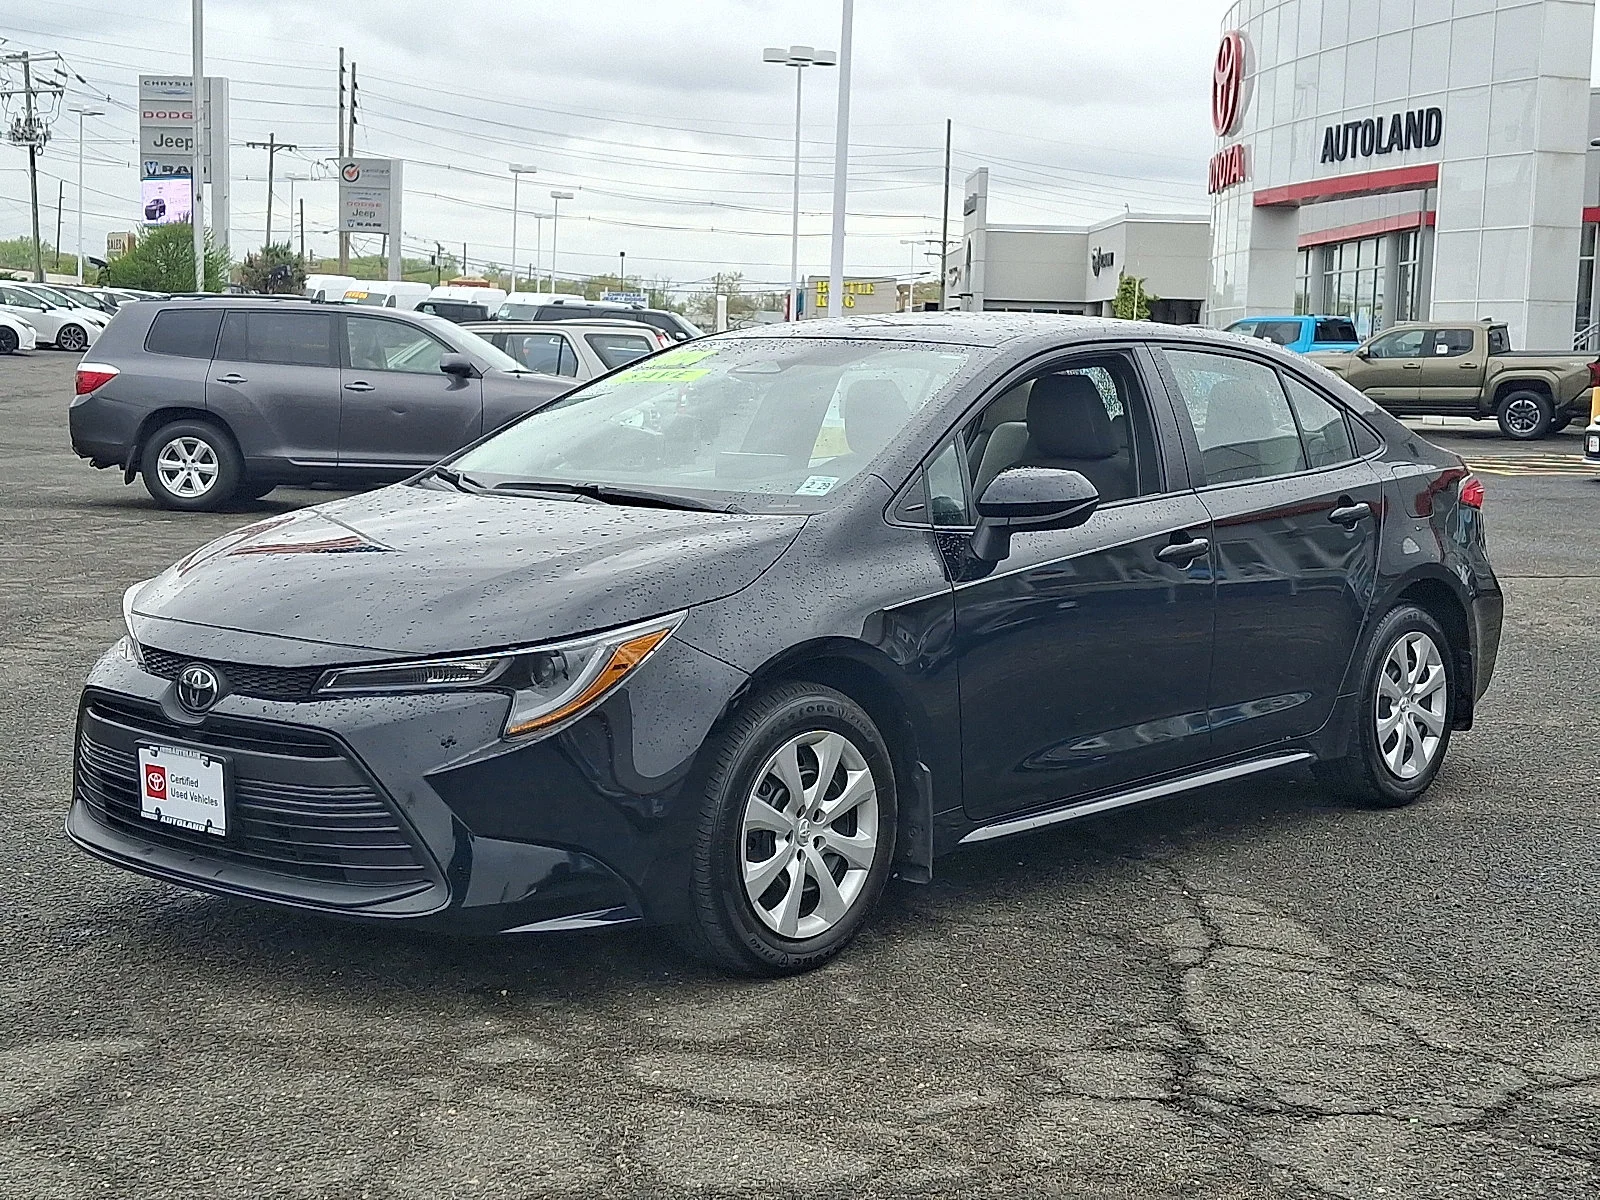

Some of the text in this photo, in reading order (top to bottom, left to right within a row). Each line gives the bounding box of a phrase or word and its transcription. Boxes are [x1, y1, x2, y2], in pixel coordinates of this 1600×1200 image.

[143, 111, 205, 119] DODG
[153, 134, 193, 151] Jeep
[1320, 107, 1442, 163] AUTOLAND
[352, 208, 376, 218] Jeep
[816, 281, 875, 295] BTLE
[816, 294, 855, 308] KG
[170, 773, 199, 788] Certified
[170, 787, 219, 807] Used Vehicles
[160, 815, 206, 832] AUTOLAND
